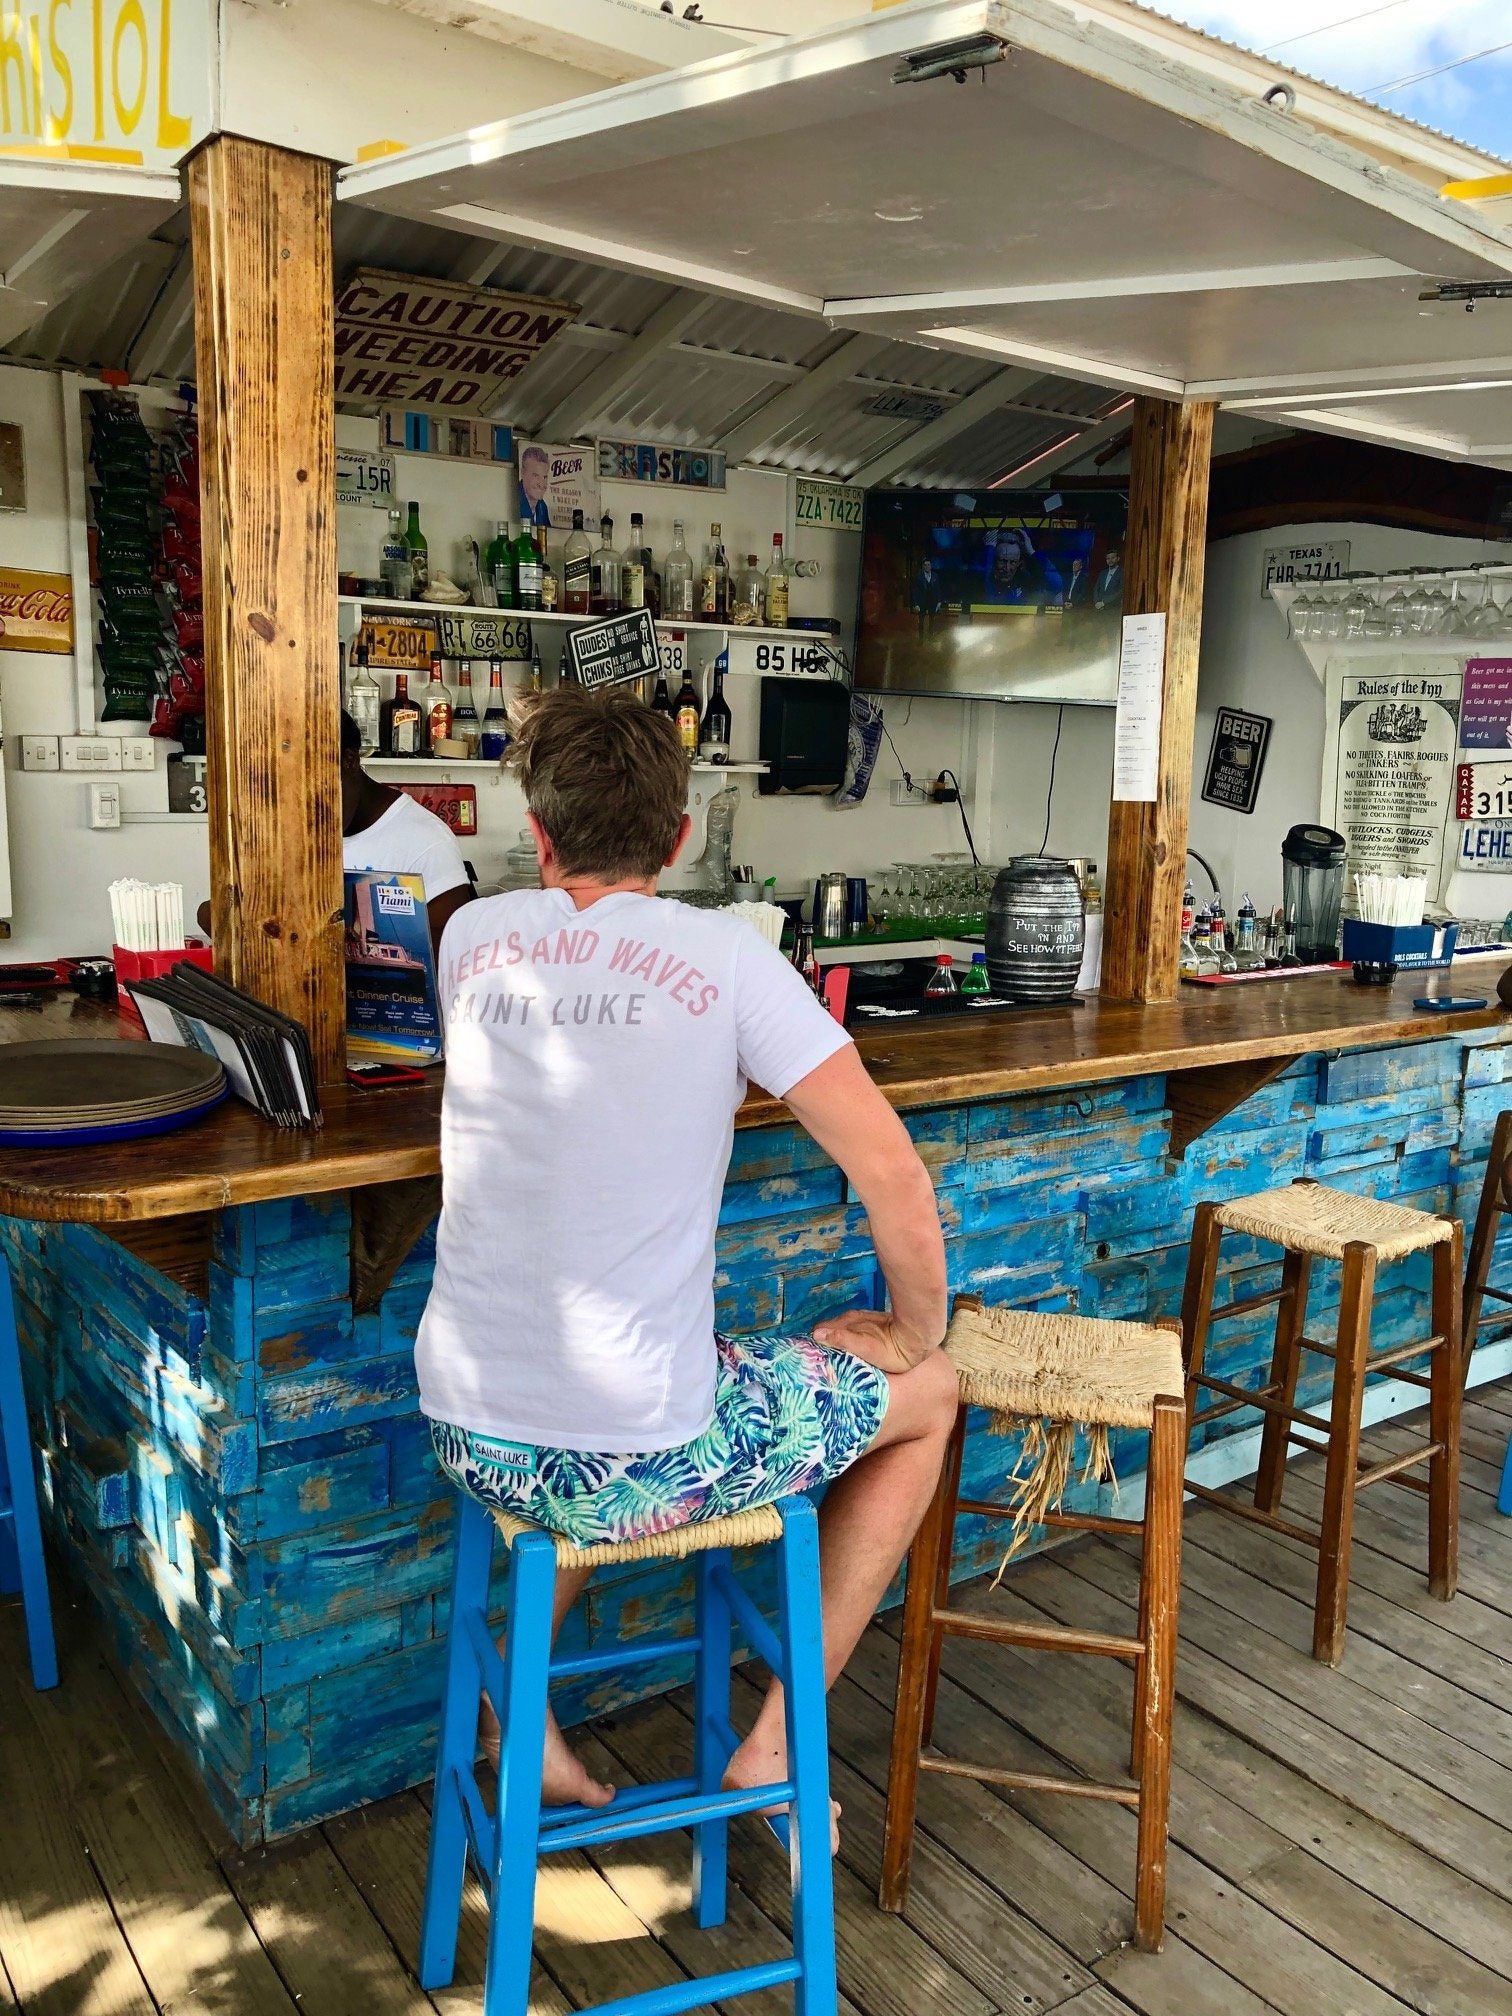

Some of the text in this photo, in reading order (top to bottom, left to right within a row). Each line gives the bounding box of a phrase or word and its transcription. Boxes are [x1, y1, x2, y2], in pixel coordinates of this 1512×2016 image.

[337, 286, 567, 344] CAUTION
[551, 458, 582, 478] BEER
[1289, 548, 1322, 560] TEXAS
[362, 616, 412, 626] NEW YORK
[615, 623, 628, 636] SHIRT
[475, 633, 495, 648] 66
[579, 632, 607, 656] DUDES
[621, 630, 638, 645] SERVICE
[718, 659, 727, 667] GB
[757, 645, 785, 671] 85
[585, 660, 612, 684] CHIKS
[1357, 680, 1442, 698] Rules of the Inn
[1463, 714, 1476, 722] Beer
[1221, 716, 1260, 743] BEER
[1346, 751, 1356, 759] NO
[1417, 752, 1449, 761] ROGUES
[1366, 760, 1399, 768] TINKERS
[1220, 765, 1245, 779] HELPING
[1345, 771, 1355, 779] NO
[1391, 771, 1422, 781] LOAFERS
[1229, 775, 1248, 788] PEOPLE
[1212, 788, 1229, 800] SINCE
[1231, 785, 1244, 795] SEX
[1460, 768, 1469, 815] QATAR
[1396, 836, 1430, 846] SWORDS
[531, 928, 600, 965] AND
[608, 936, 719, 1017] WAVES
[357, 989, 389, 1001] Dinner
[392, 992, 424, 1004] Cruise
[450, 993, 646, 1026] SAINT LUKE
[475, 1443, 528, 1466] SAINT LUKE
